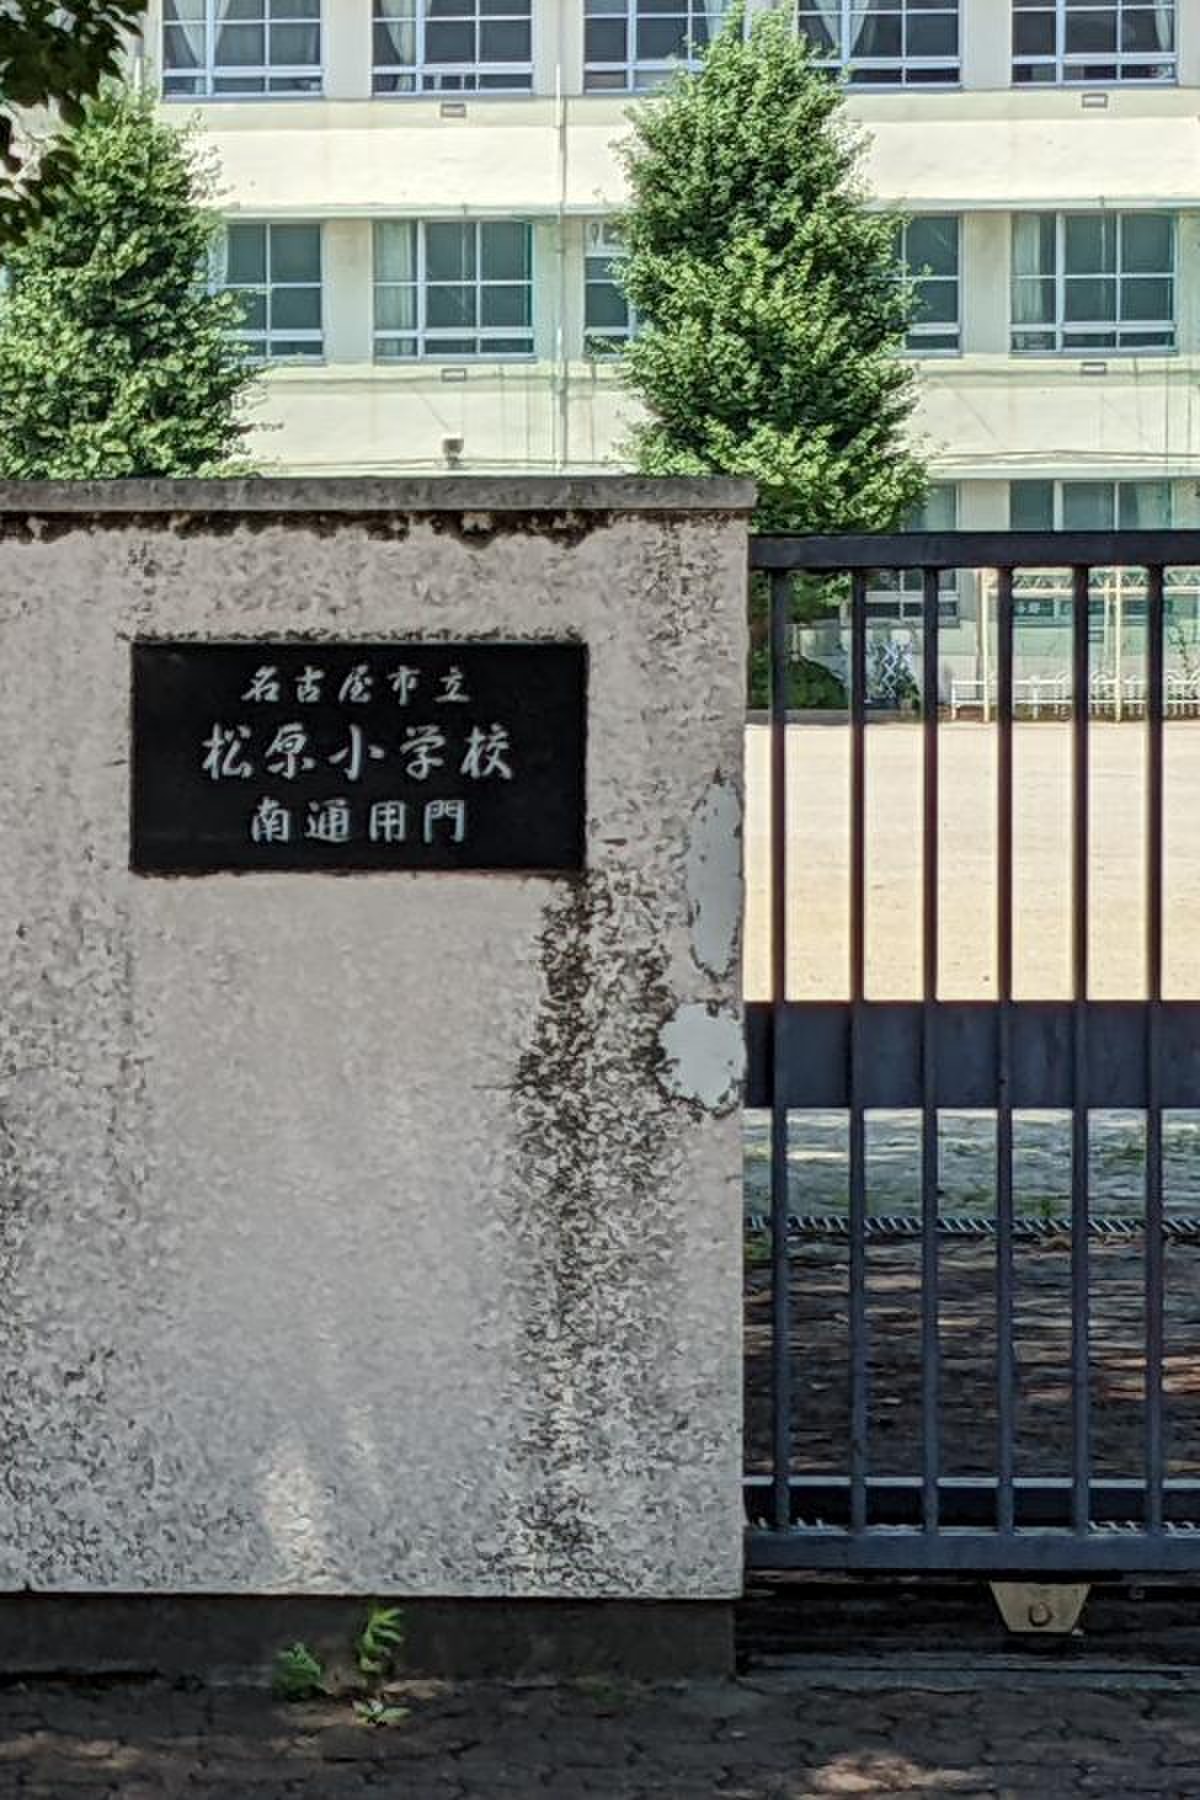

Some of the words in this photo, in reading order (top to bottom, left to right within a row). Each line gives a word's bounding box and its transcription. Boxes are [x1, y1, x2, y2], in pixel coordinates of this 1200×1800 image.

[242, 664, 471, 706] 名古屋市立
[200, 721, 514, 781] 松原小学校
[250, 796, 467, 844] 南通用門
